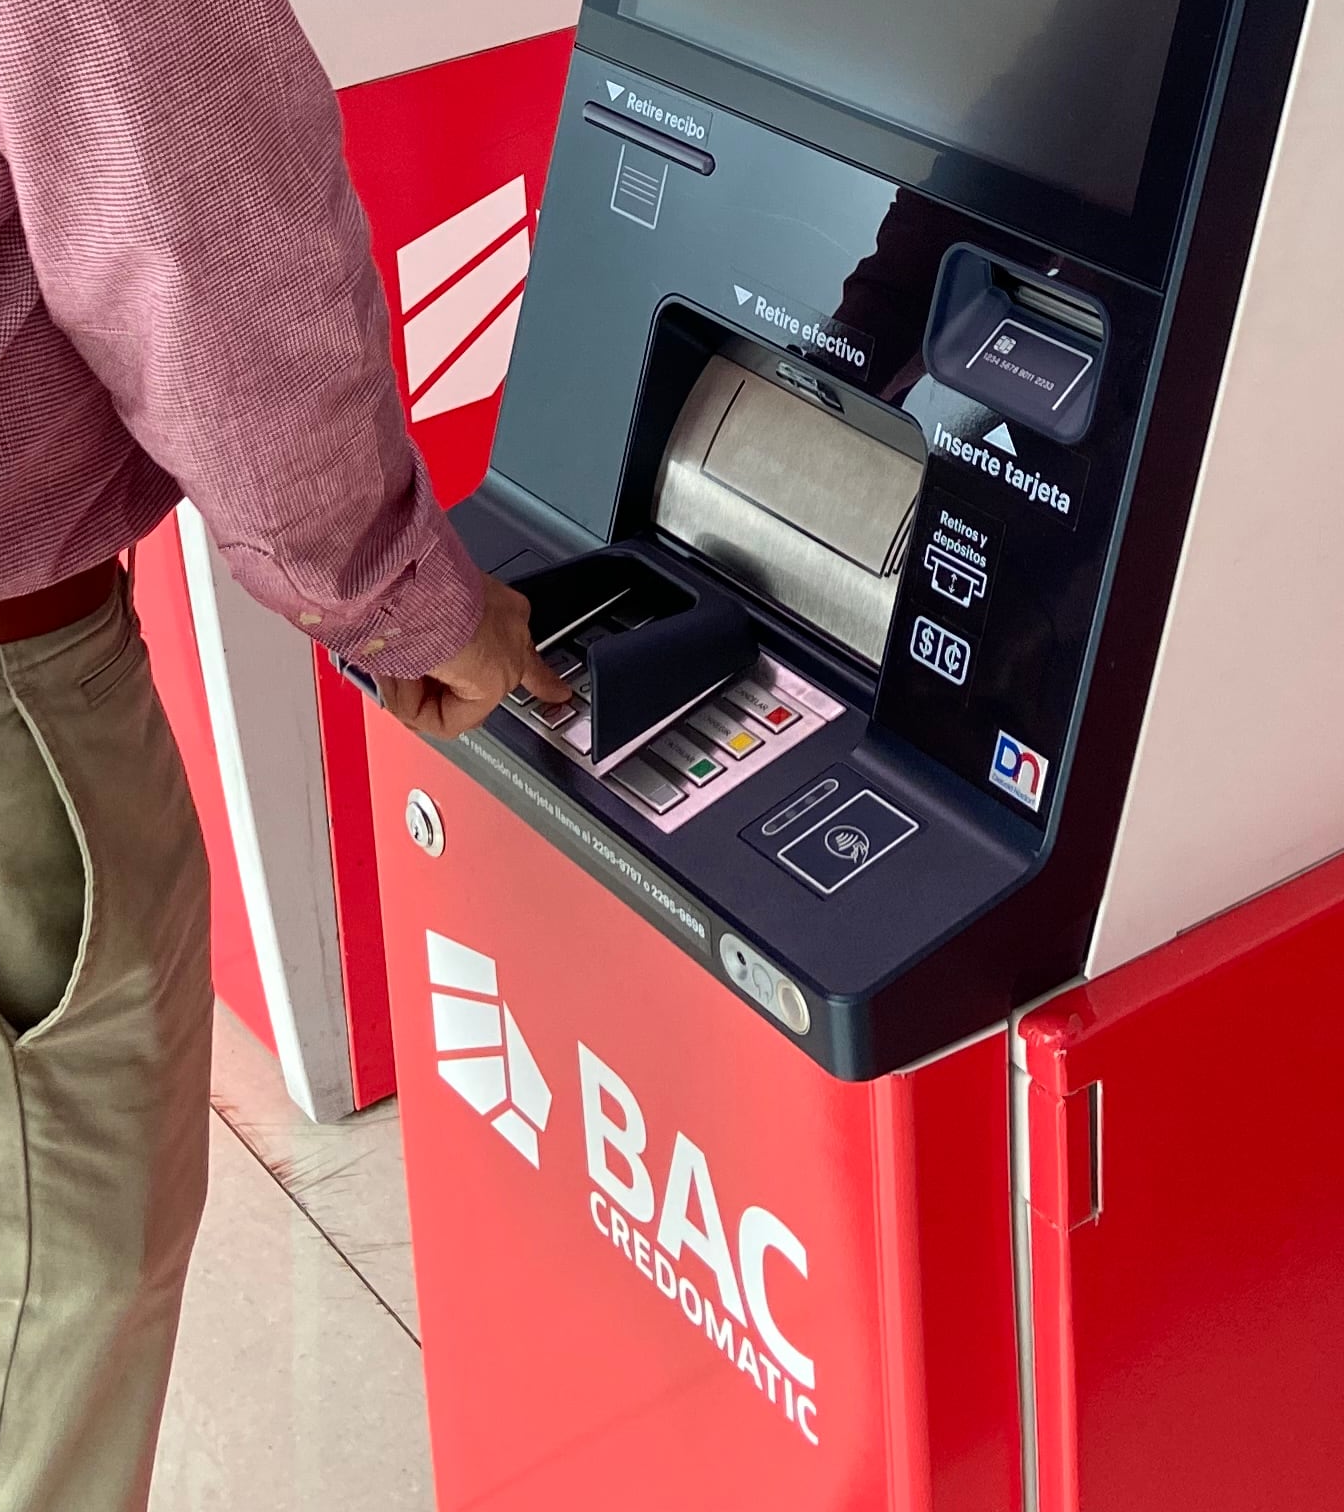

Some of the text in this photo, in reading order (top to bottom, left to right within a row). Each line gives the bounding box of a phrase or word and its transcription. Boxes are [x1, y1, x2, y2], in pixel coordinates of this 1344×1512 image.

[626, 92, 705, 140] Retire recibo
[755, 295, 865, 367] Retire efectivo
[983, 352, 1001, 366] 1234
[999, 360, 1020, 374] 5678
[933, 422, 1071, 514] Inserte tarjeta
[933, 528, 987, 568] depósitos
[939, 509, 988, 548] Retiros y
[919, 626, 935, 658] $
[470, 740, 512, 779] retención
[512, 773, 524, 790] de
[524, 782, 554, 816] tarjeta
[643, 881, 650, 892] o
[578, 1040, 816, 1391] BAC
[589, 1190, 820, 1447] CREDOMATIC
